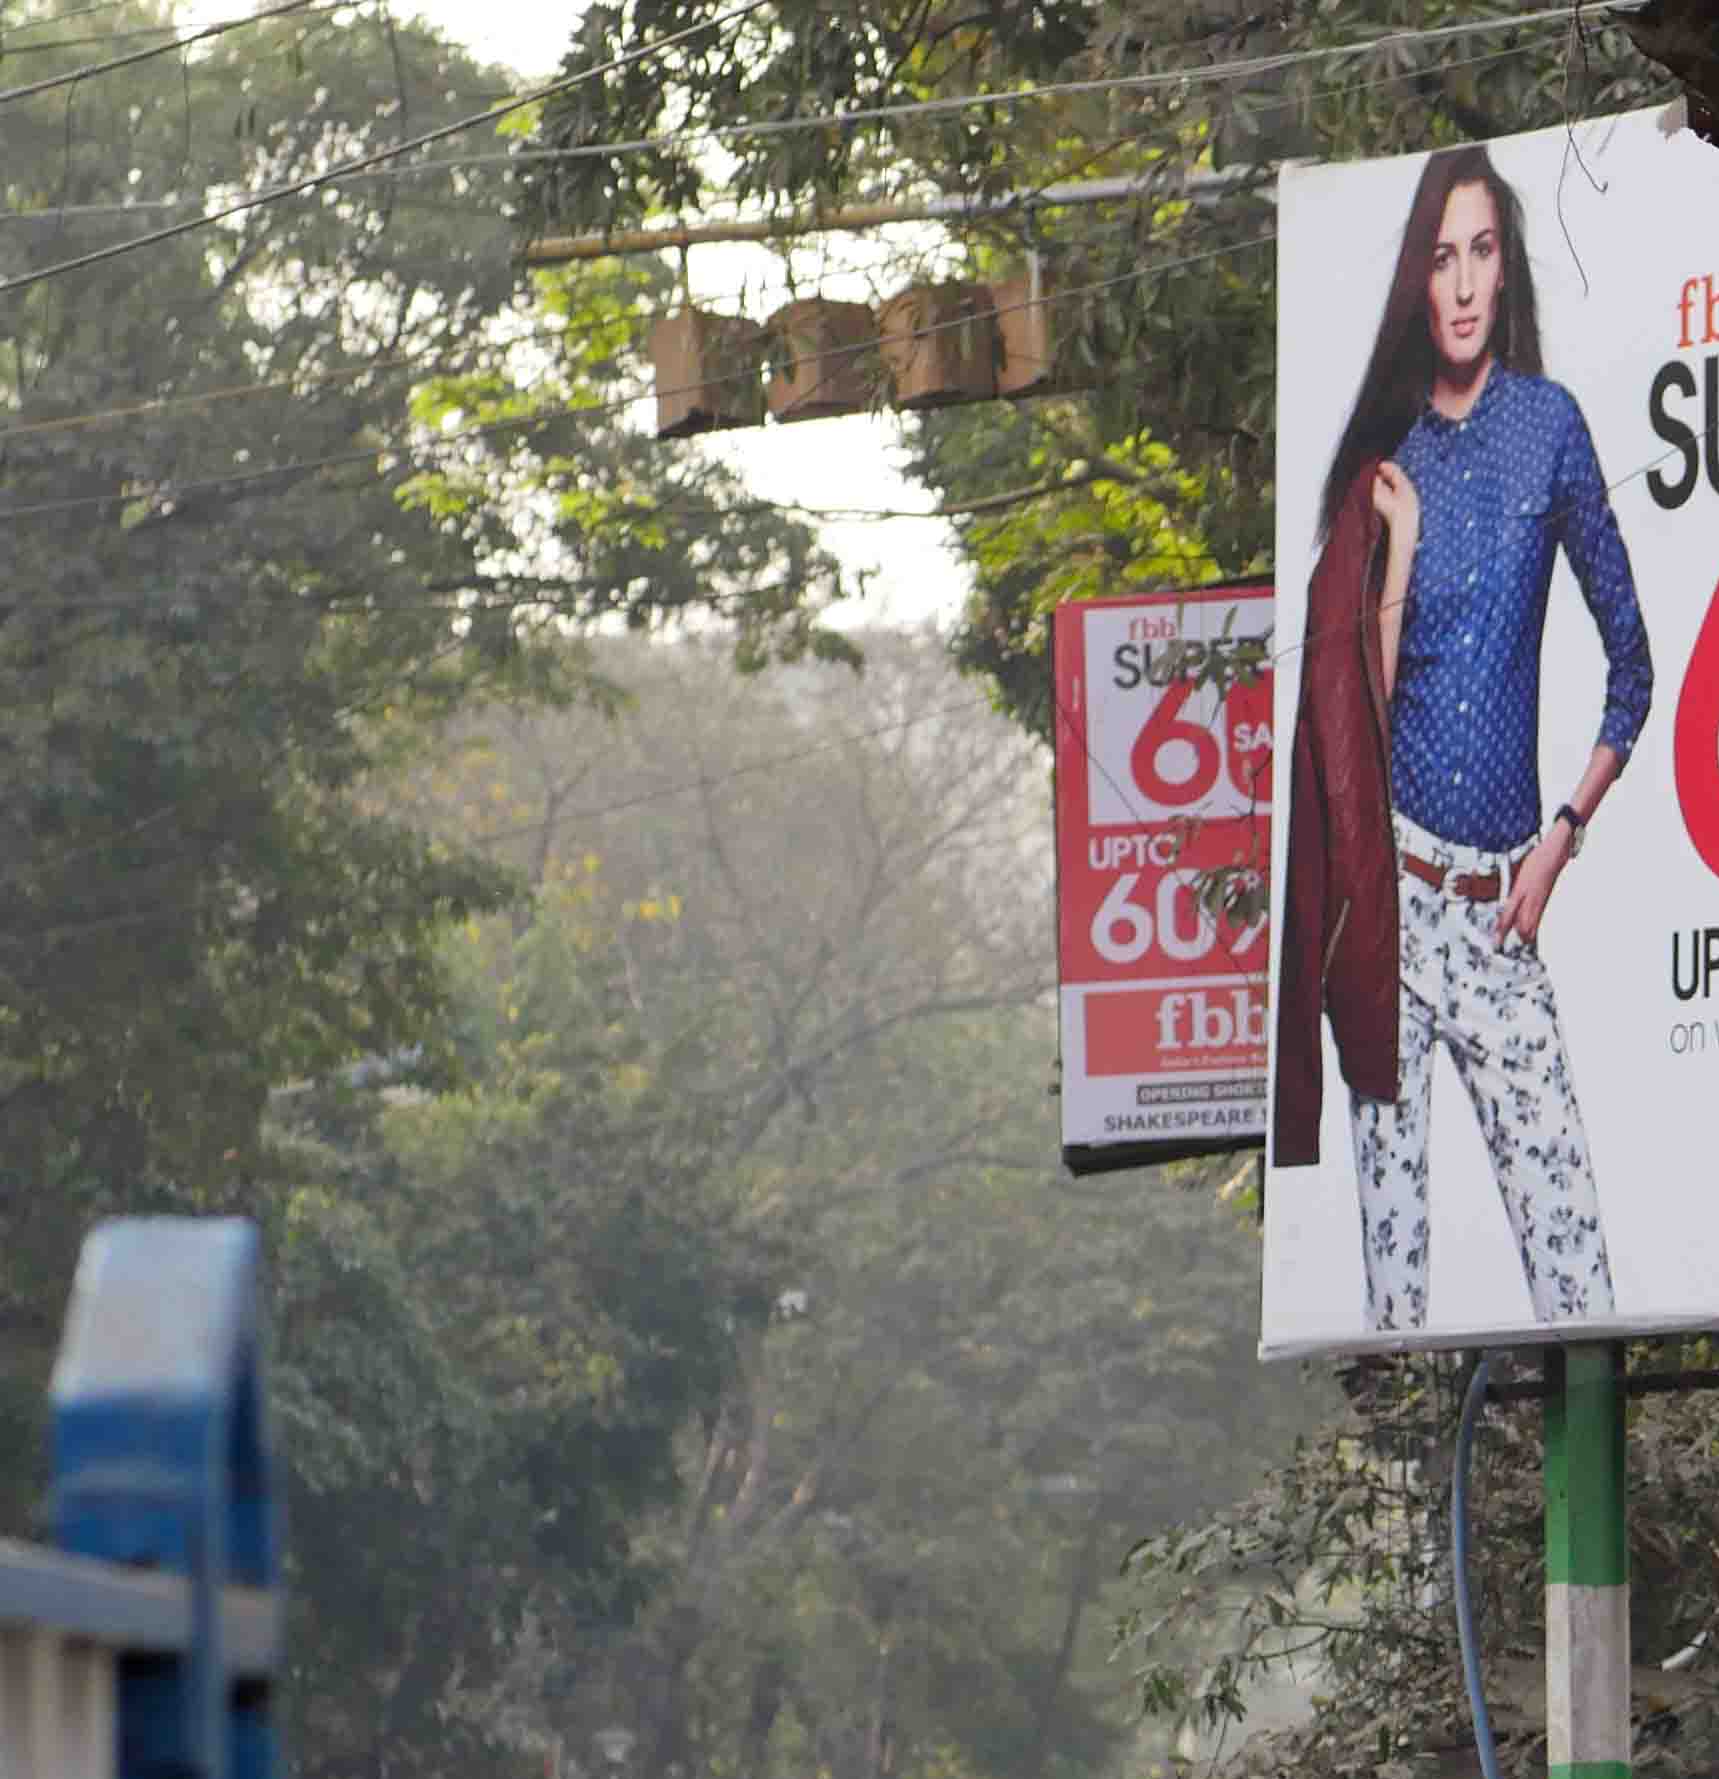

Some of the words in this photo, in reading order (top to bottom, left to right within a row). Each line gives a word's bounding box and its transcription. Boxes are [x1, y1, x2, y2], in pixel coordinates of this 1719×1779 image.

[1129, 616, 1177, 640] fbb
[1670, 1020, 1704, 1054] on
[1104, 1107, 1254, 1132] SHAKESPEARE
